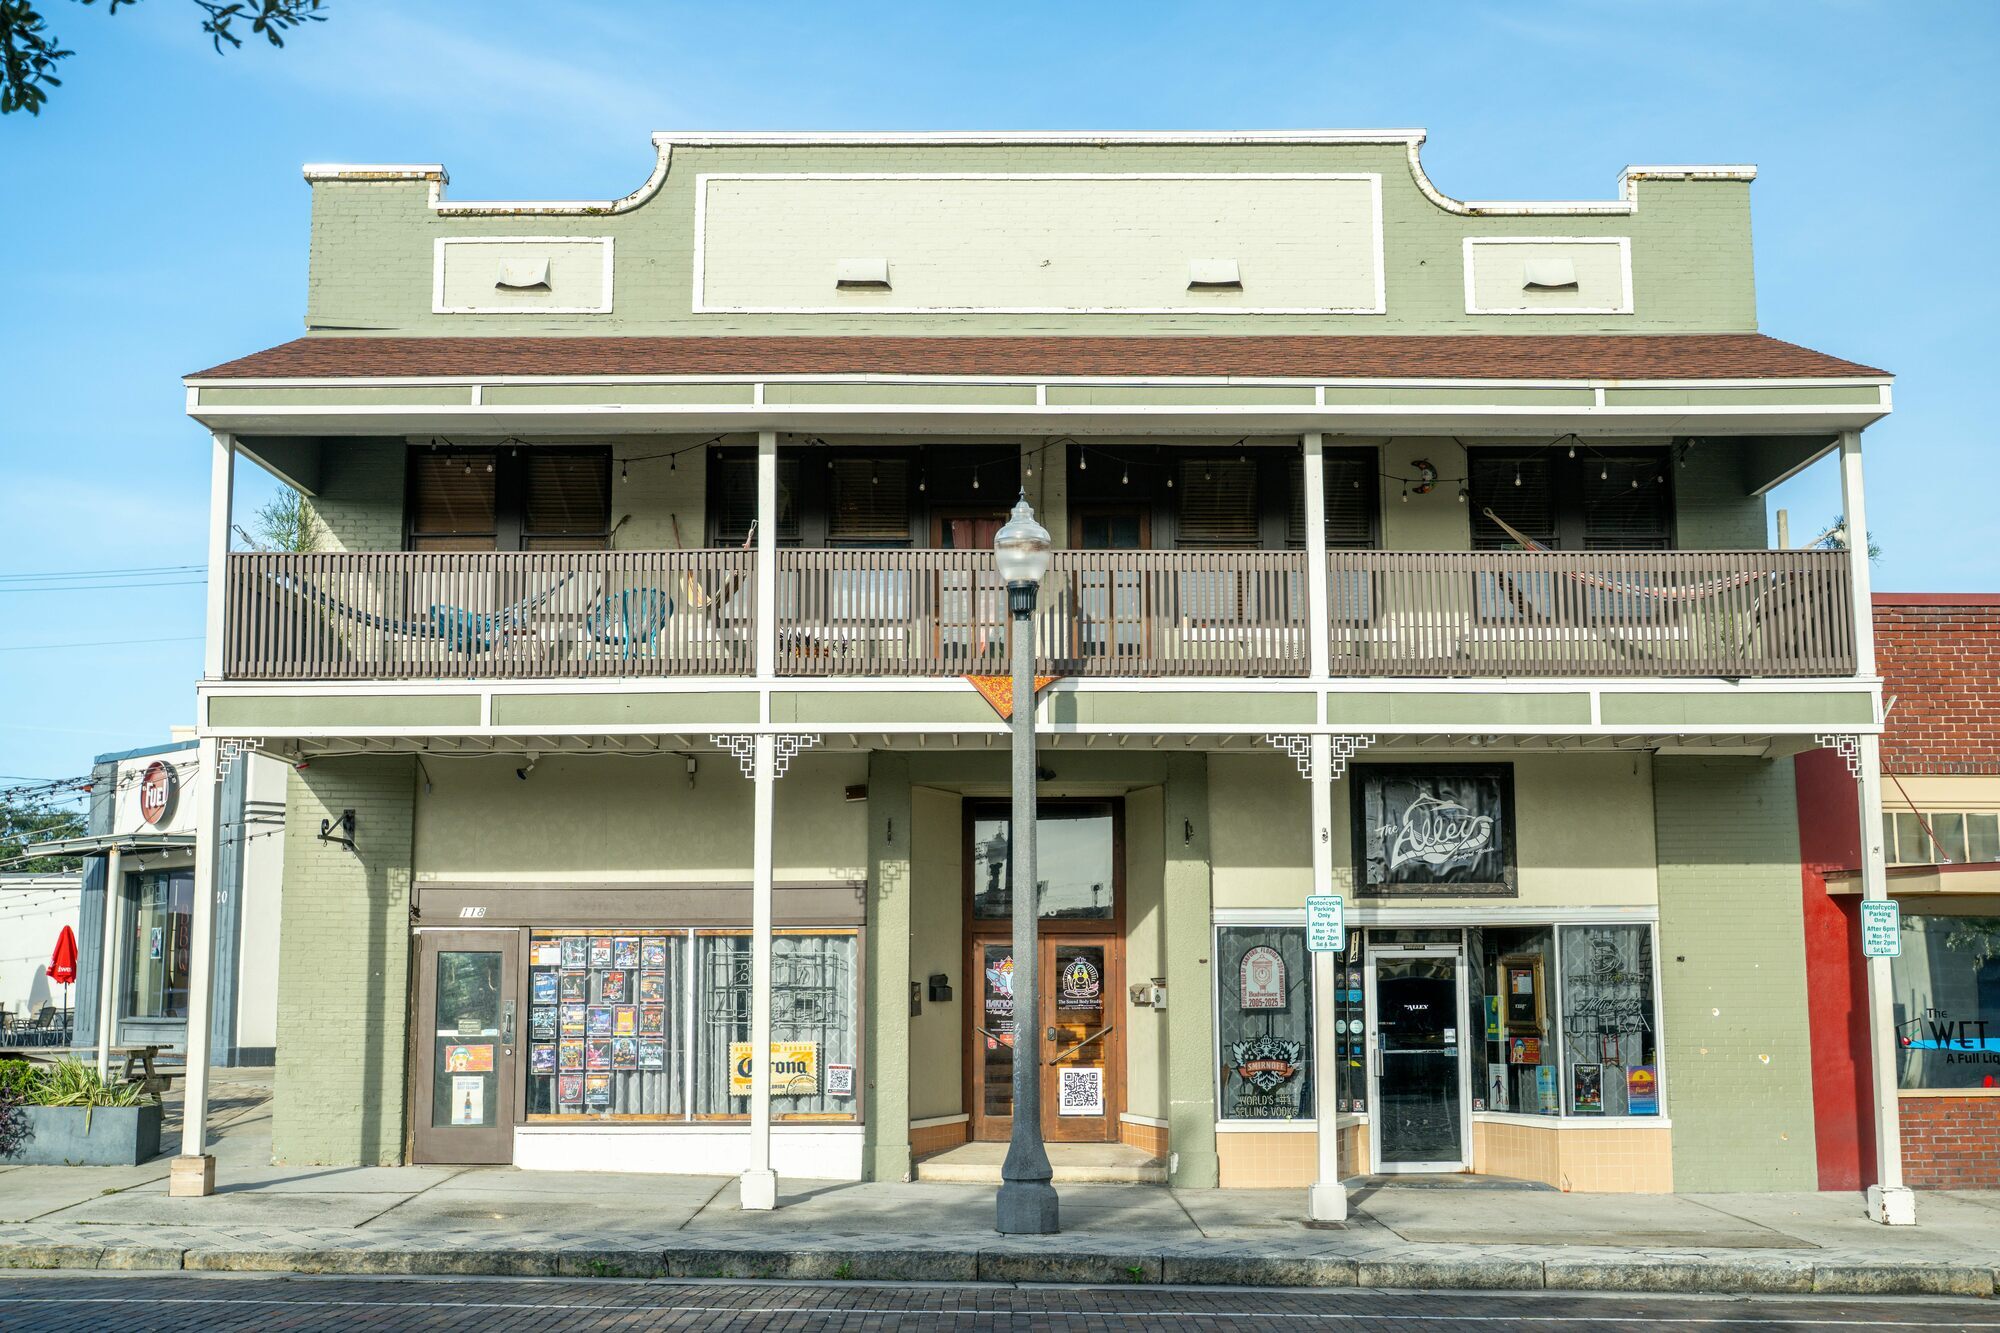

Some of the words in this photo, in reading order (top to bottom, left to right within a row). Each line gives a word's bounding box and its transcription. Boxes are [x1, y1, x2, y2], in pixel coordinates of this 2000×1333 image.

[1375, 823, 1398, 837] The
[1391, 816, 1494, 870] Alley
[143, 884, 166, 905] OPEN
[463, 908, 485, 918] 118
[1350, 933, 1359, 961] 114
[986, 1000, 1014, 1008] HARMON
[1249, 998, 1278, 1007] 2005-2025
[1926, 1008, 1947, 1018] The
[1567, 1011, 1651, 1038] ULTRA
[1928, 1021, 1989, 1050] WET
[1946, 1054, 1954, 1063] A
[1958, 1053, 1979, 1063] Full
[737, 1057, 808, 1077] Cona
[1247, 1061, 1285, 1071] SMIRNOFF
[1240, 1095, 1274, 1105] WORLD'S
[1279, 1094, 1292, 1105] #1
[1235, 1107, 1268, 1117] SELLING
